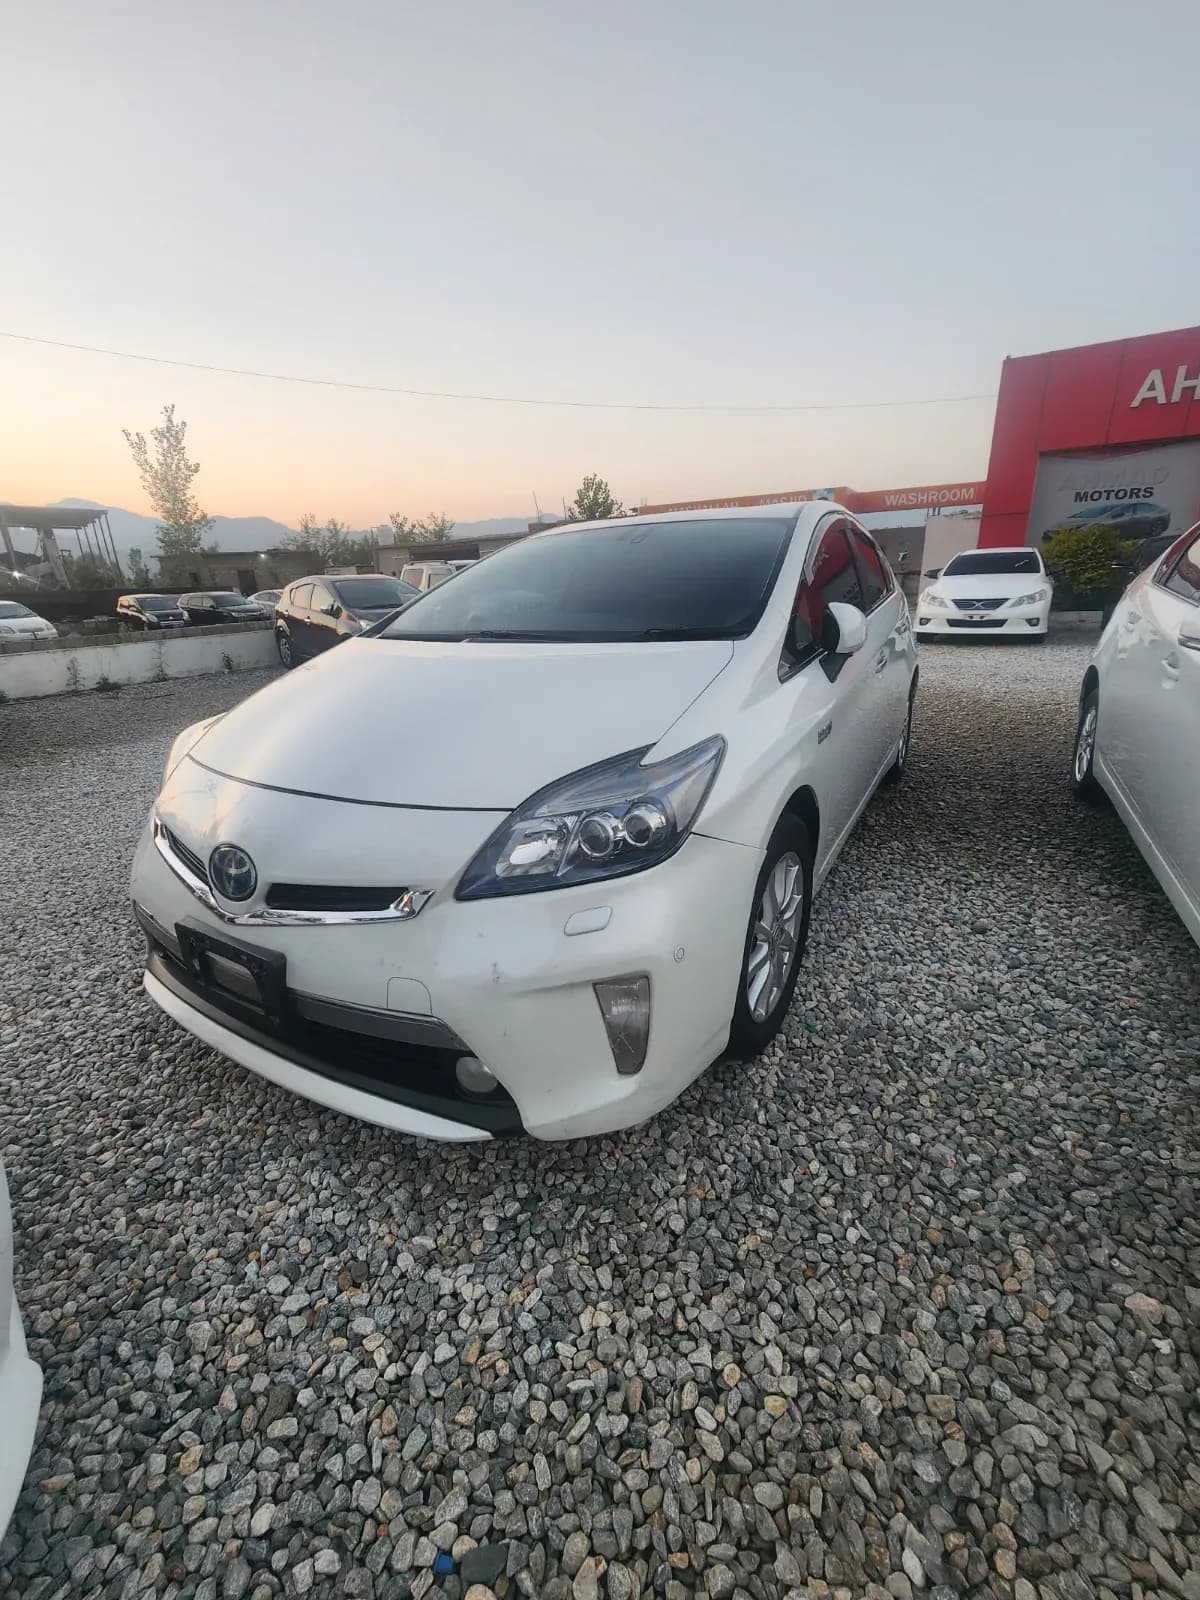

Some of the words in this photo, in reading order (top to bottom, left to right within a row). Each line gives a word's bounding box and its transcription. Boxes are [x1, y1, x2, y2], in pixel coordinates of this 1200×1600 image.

[1129, 365, 1200, 408] AH
[885, 488, 975, 507] WASHROOM
[1074, 486, 1154, 503] MOTORS
